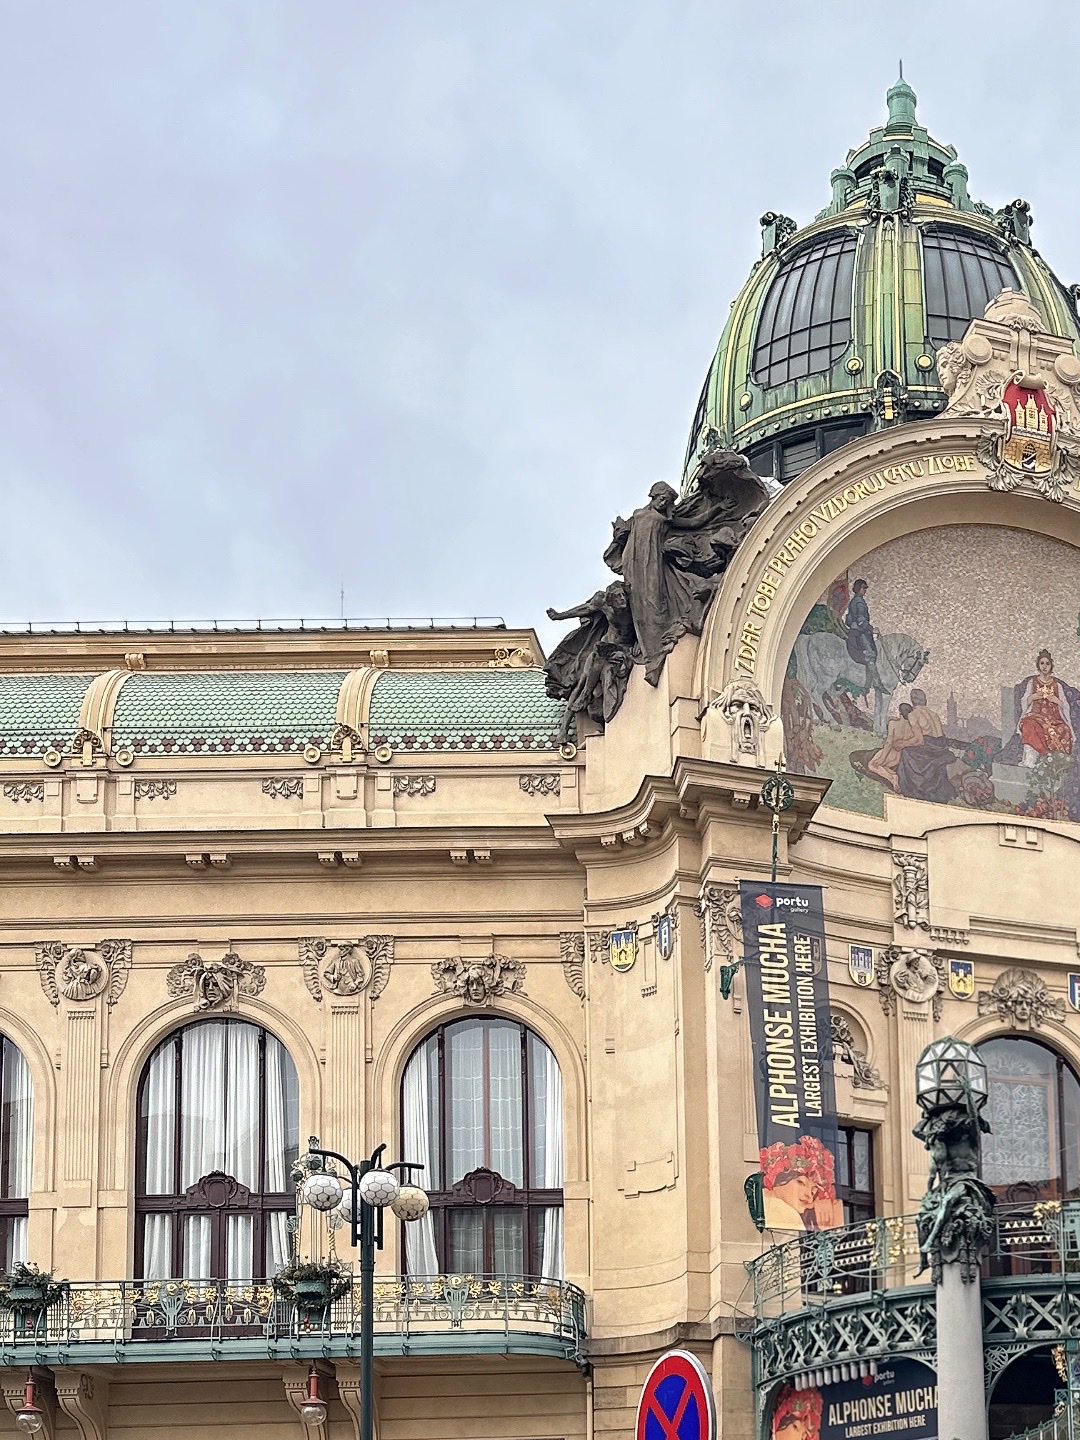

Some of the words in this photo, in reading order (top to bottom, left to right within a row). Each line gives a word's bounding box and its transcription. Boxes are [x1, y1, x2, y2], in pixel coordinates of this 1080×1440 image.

[734, 621, 763, 674] ZDAR
[775, 897, 809, 907] portu
[757, 923, 791, 1003] MUCHA
[793, 935, 813, 972] HERE
[796, 976, 818, 1053] EXHIBITION
[763, 1008, 801, 1129] ALPHONSE
[801, 1056, 823, 1118] LARGEST
[874, 1370, 895, 1383] portu
[828, 1393, 893, 1426] ALPHONSE
[845, 1423, 873, 1438] LARGEST
[873, 1416, 909, 1434] EXHIBITION
[909, 1414, 926, 1428] HERE
